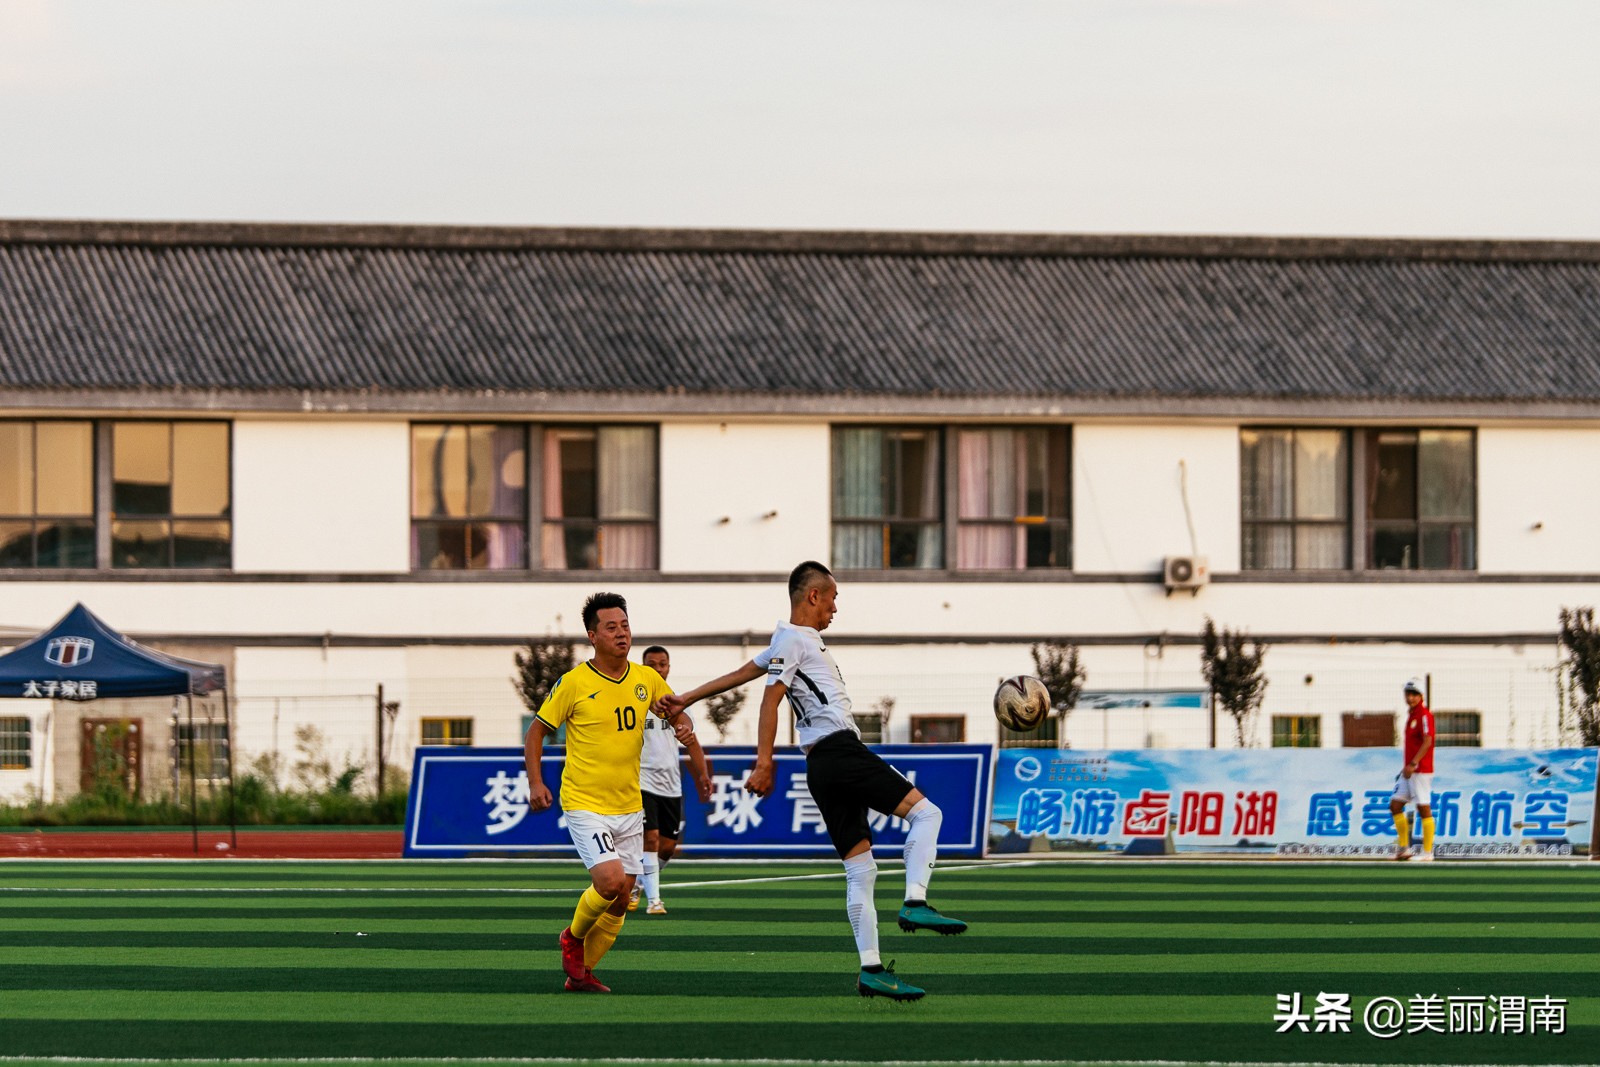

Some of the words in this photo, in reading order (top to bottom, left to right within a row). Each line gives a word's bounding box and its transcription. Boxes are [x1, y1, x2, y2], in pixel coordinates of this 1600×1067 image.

[22, 680, 98, 700] 太子家居
[614, 705, 637, 732] 10
[1018, 789, 1278, 836] 畅游卤阳湖
[1306, 789, 1569, 837] 感受新航空
